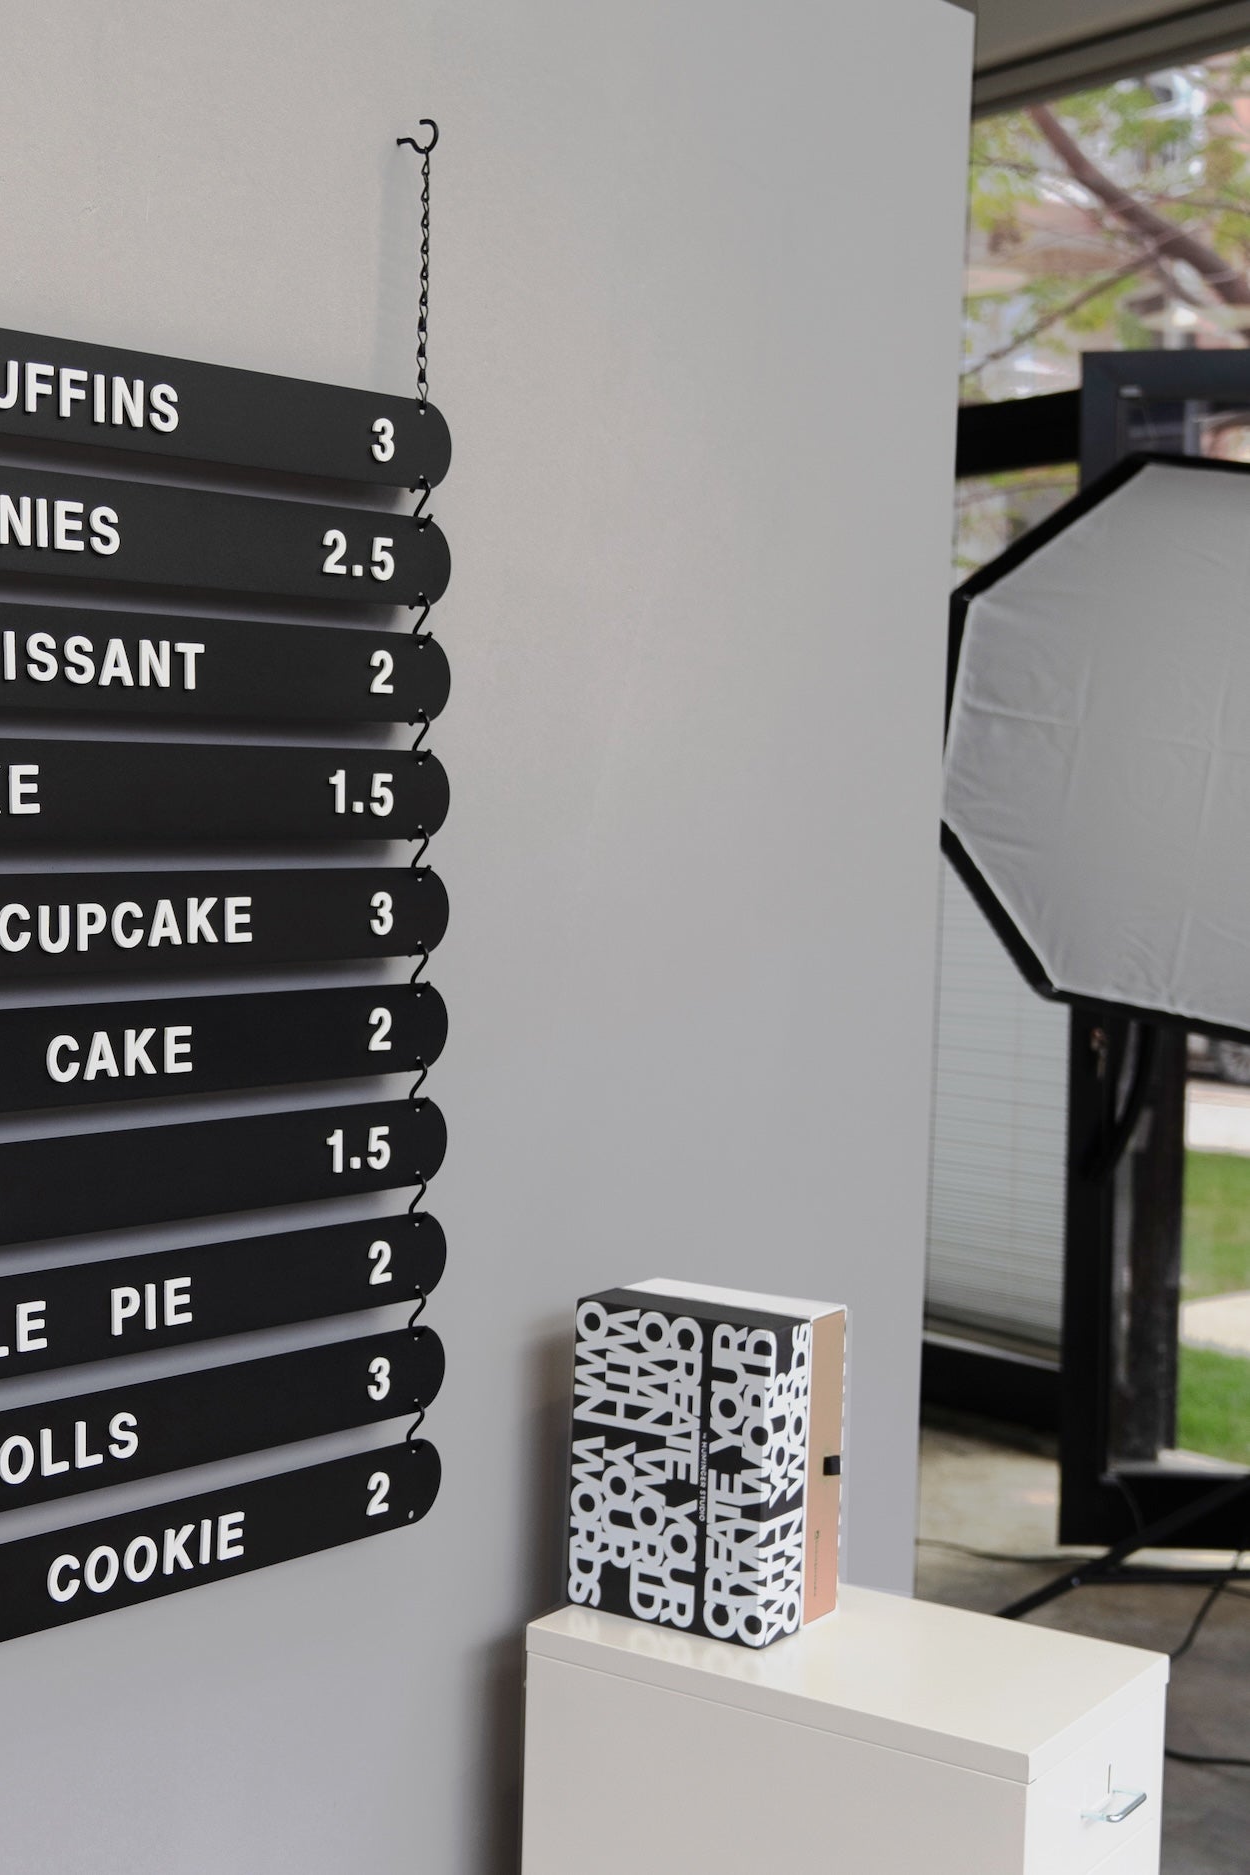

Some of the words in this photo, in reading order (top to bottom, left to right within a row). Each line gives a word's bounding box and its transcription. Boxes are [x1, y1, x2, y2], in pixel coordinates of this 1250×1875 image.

[371, 417, 395, 462] 3
[322, 529, 395, 581] 2.5
[370, 649, 394, 694] 2
[328, 769, 394, 817] 1.5
[370, 891, 394, 936] 3
[46, 1025, 193, 1083] CAKE
[368, 1007, 392, 1051] 2
[326, 1125, 391, 1173] 1.5
[110, 1276, 193, 1336] PIE
[368, 1240, 392, 1285] 2
[367, 1356, 391, 1401] 3
[574, 1301, 608, 1424] OWN
[632, 1311, 671, 1437] OWN
[665, 1316, 703, 1485] CREATE
[709, 1324, 748, 1454] YOUR
[741, 1329, 776, 1507] WORLD
[786, 1322, 811, 1501] WORDS
[764, 1373, 788, 1508] YOUR
[47, 1511, 245, 1602] COOKIE
[366, 1471, 390, 1516] 2
[568, 1436, 605, 1607] WORDS
[598, 1441, 636, 1568] YOUR
[629, 1448, 666, 1620] WORLD
[660, 1499, 698, 1628] YOUR
[698, 1489, 706, 1522] STUDIO
[703, 1469, 741, 1638] CREATE
[736, 1517, 767, 1647] OWN
[782, 1507, 802, 1634] OWN
